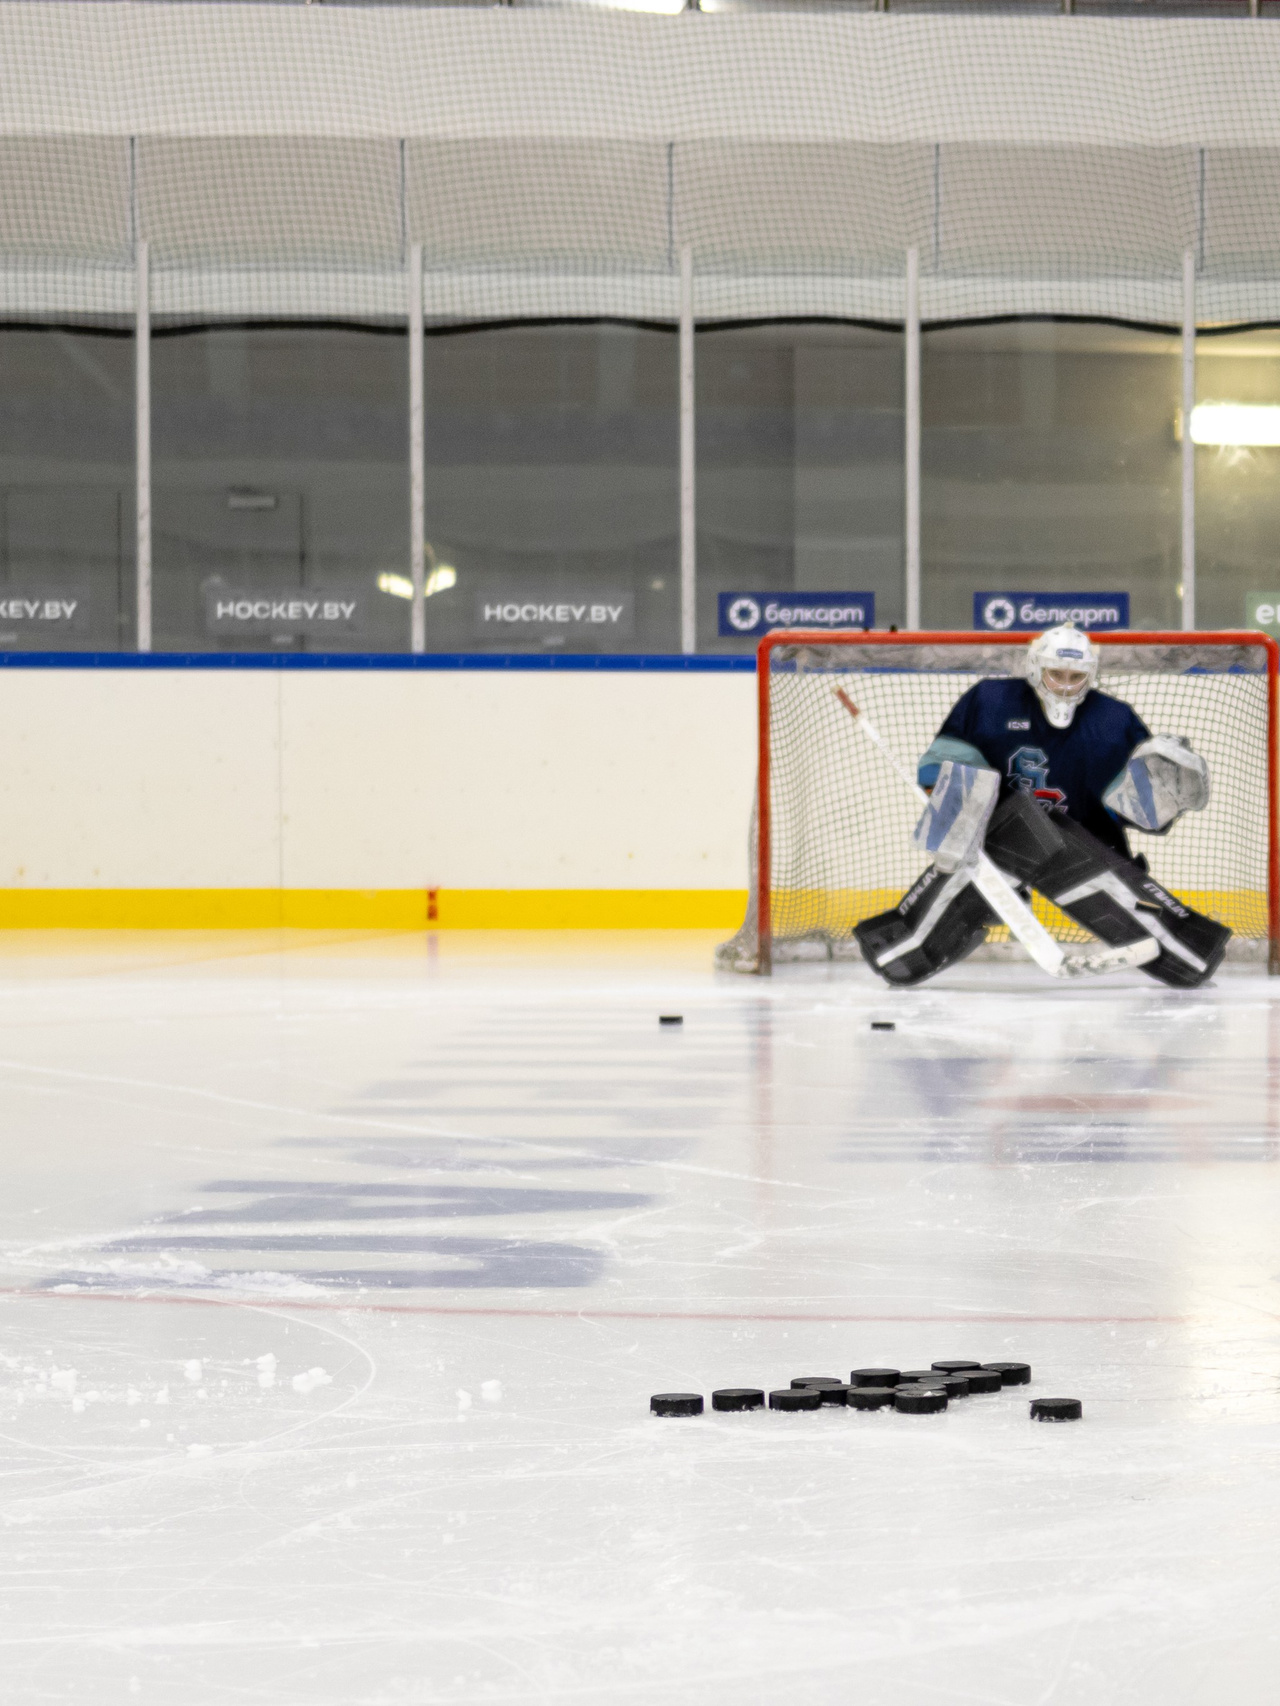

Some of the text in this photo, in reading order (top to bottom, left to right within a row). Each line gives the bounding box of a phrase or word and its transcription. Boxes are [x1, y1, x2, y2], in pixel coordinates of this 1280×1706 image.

[216, 601, 356, 620] HOCKEY.BY
[484, 604, 623, 623] HOCKEY.BY
[764, 603, 865, 627] белкарт
[1020, 602, 1118, 628] белкарт
